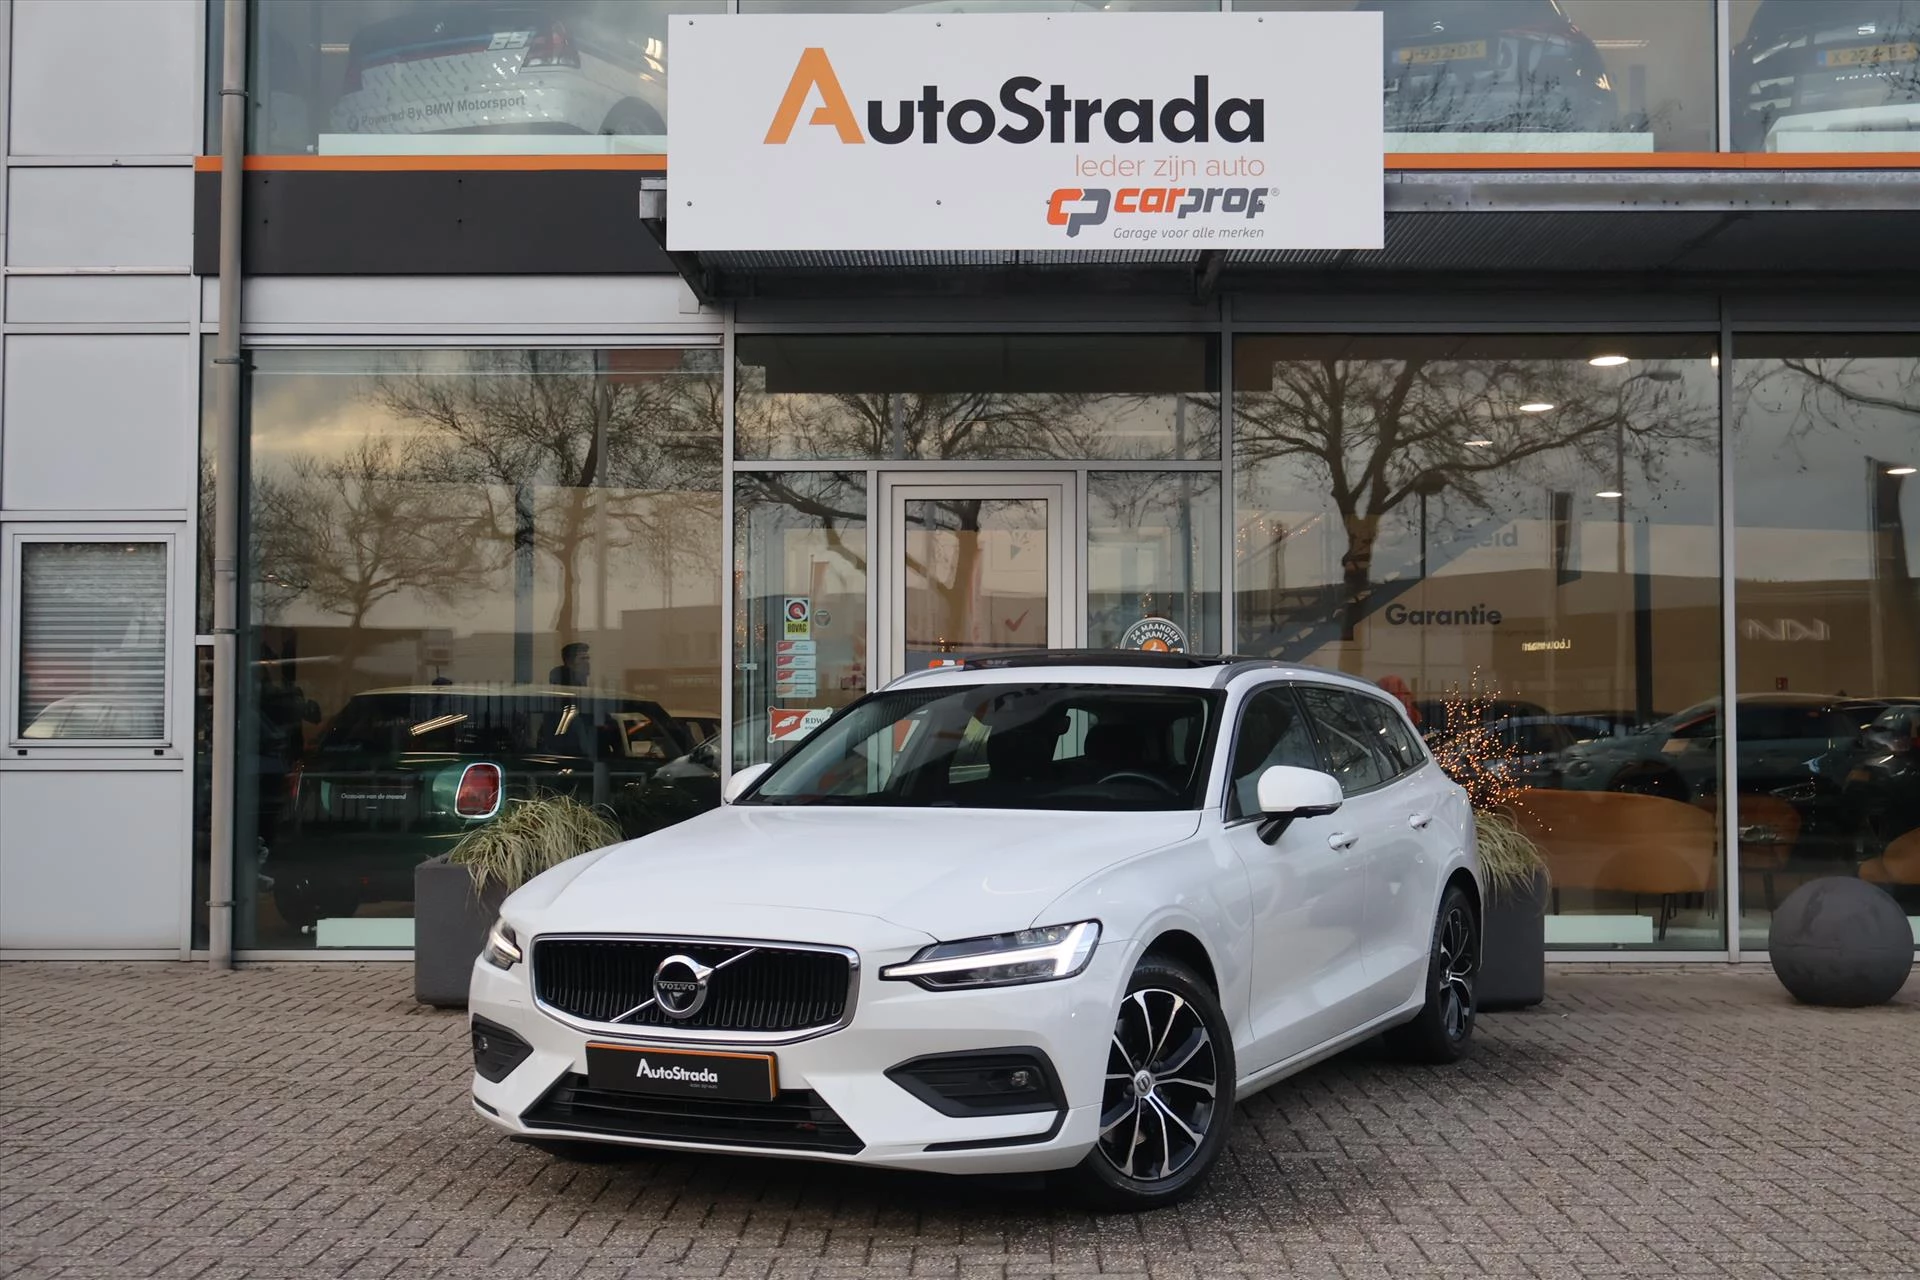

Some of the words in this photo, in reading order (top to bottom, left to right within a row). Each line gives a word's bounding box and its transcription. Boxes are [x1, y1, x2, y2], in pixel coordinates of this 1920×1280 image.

[763, 47, 1264, 144] AutoStrada
[361, 109, 405, 126] Powered
[407, 107, 422, 118] By
[426, 102, 454, 116] BMW
[457, 95, 526, 112] Motorsport
[1075, 155, 1145, 177] Ieder
[1153, 155, 1196, 182] zijn
[1206, 155, 1265, 177] auto
[1113, 227, 1157, 240] Garage
[1161, 229, 1188, 239] voor
[1192, 227, 1214, 239] alle
[1218, 227, 1264, 239] merken
[1385, 603, 1502, 625] Garantie
[787, 623, 807, 633] BOVAG
[1130, 629, 1141, 641] 24
[1140, 623, 1180, 642] MAANDEN
[1136, 630, 1174, 646] GARANTIE
[659, 982, 696, 991] VOLVO
[636, 1058, 718, 1082] AutoStrada
